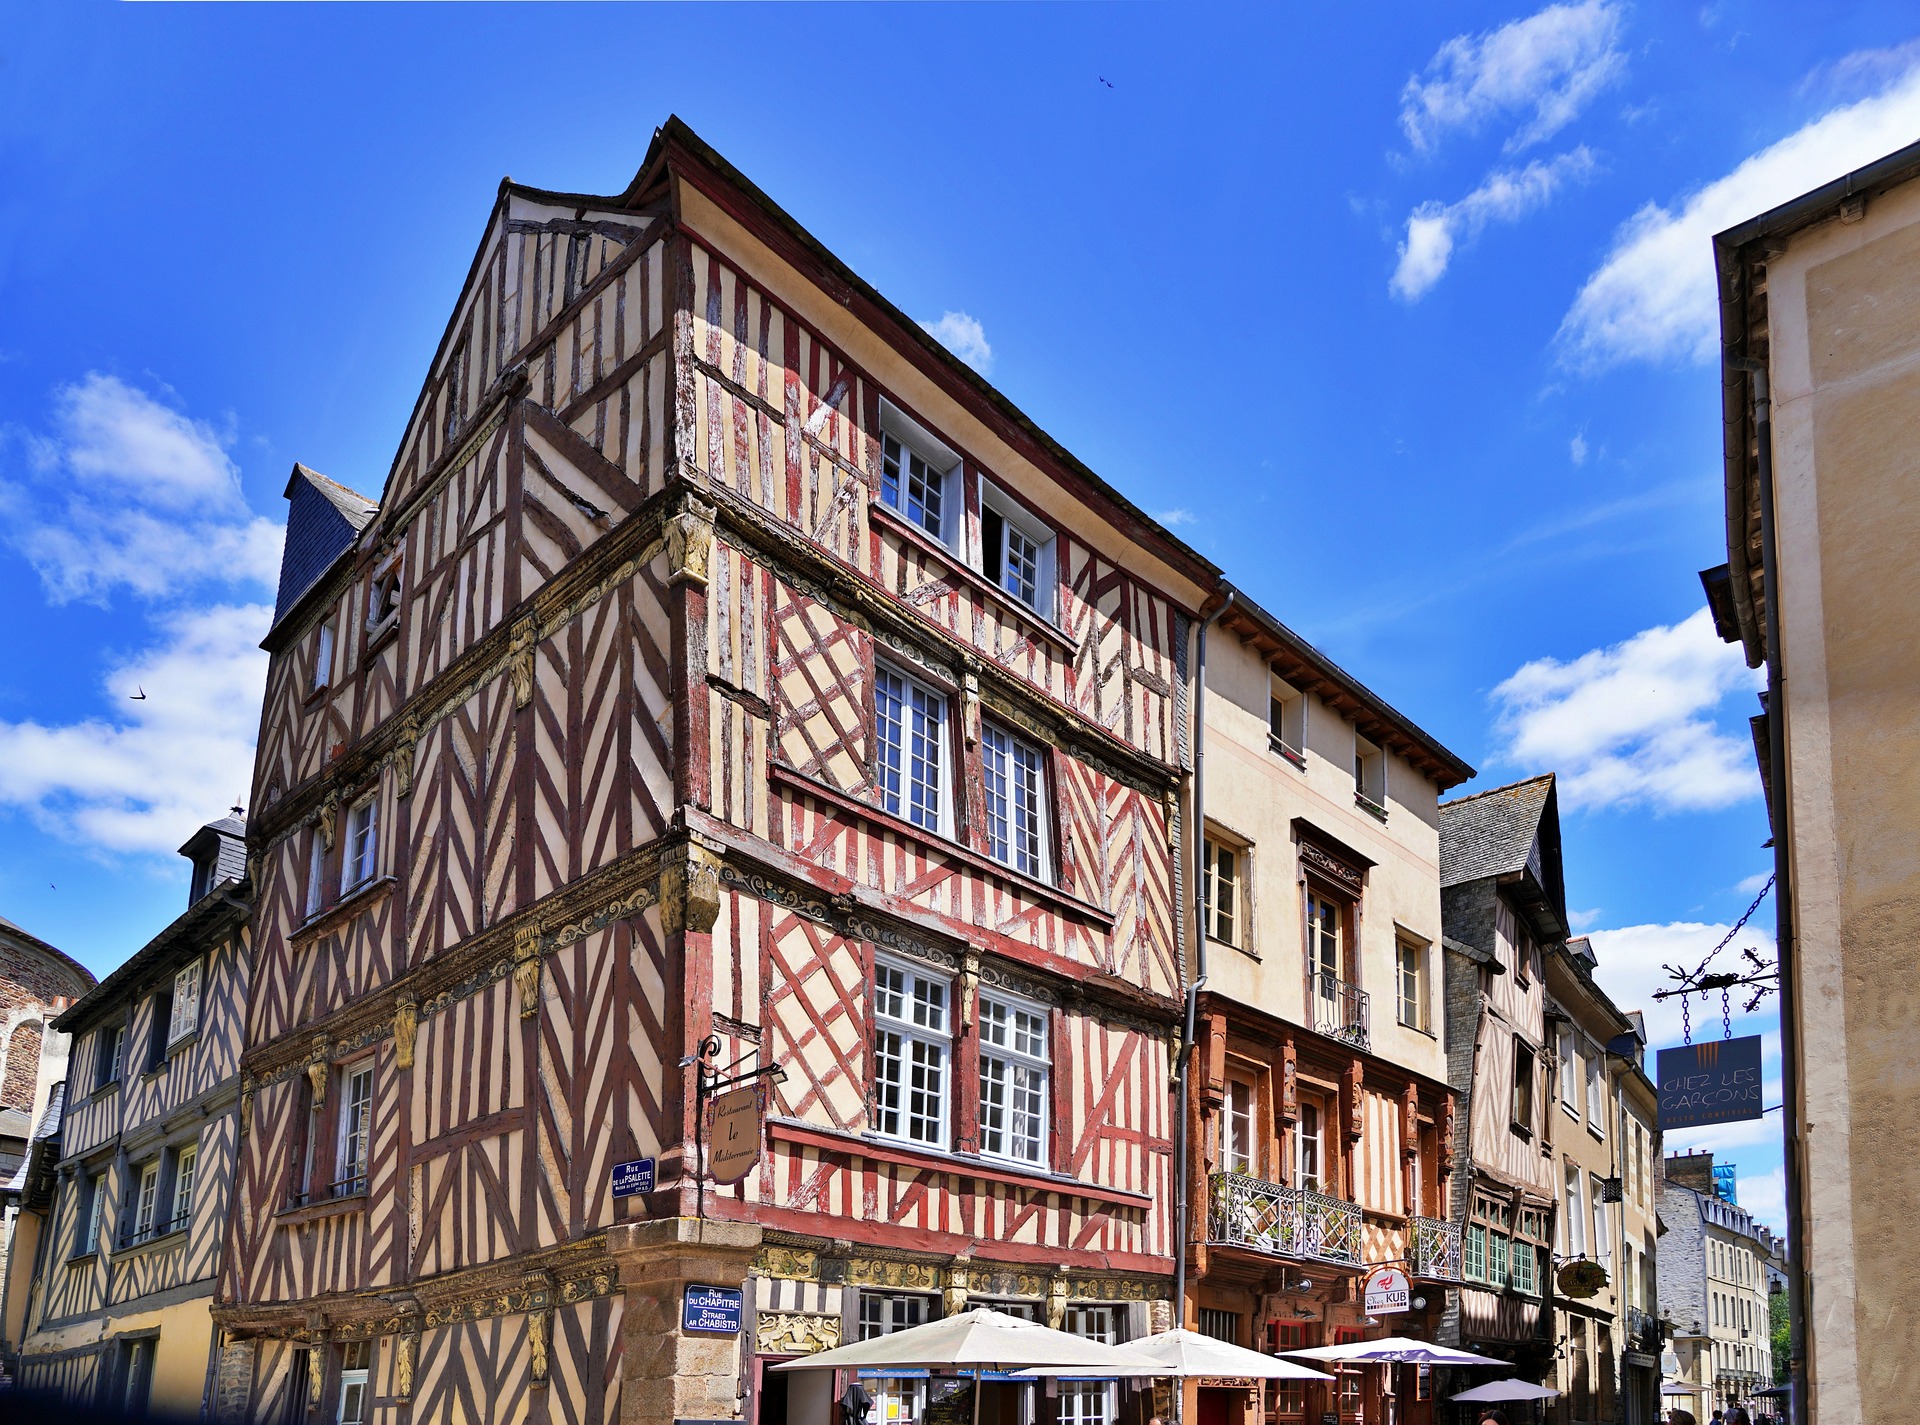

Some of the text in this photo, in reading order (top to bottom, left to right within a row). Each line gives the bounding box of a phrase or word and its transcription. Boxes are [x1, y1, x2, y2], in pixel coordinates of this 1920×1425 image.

[1663, 1067, 1756, 1092] CHEZ LES
[1661, 1084, 1760, 1110] GARÇONS
[717, 1100, 753, 1118] Restaurant
[1702, 1108, 1753, 1119] CONVIVIAL
[728, 1122, 738, 1141] le
[713, 1147, 755, 1165] Méditerranée
[625, 1171, 651, 1183] PSALETTE
[699, 1297, 740, 1309] CHAPITRE
[1386, 1292, 1407, 1303] KUB
[698, 1318, 737, 1329] CHABISTR
